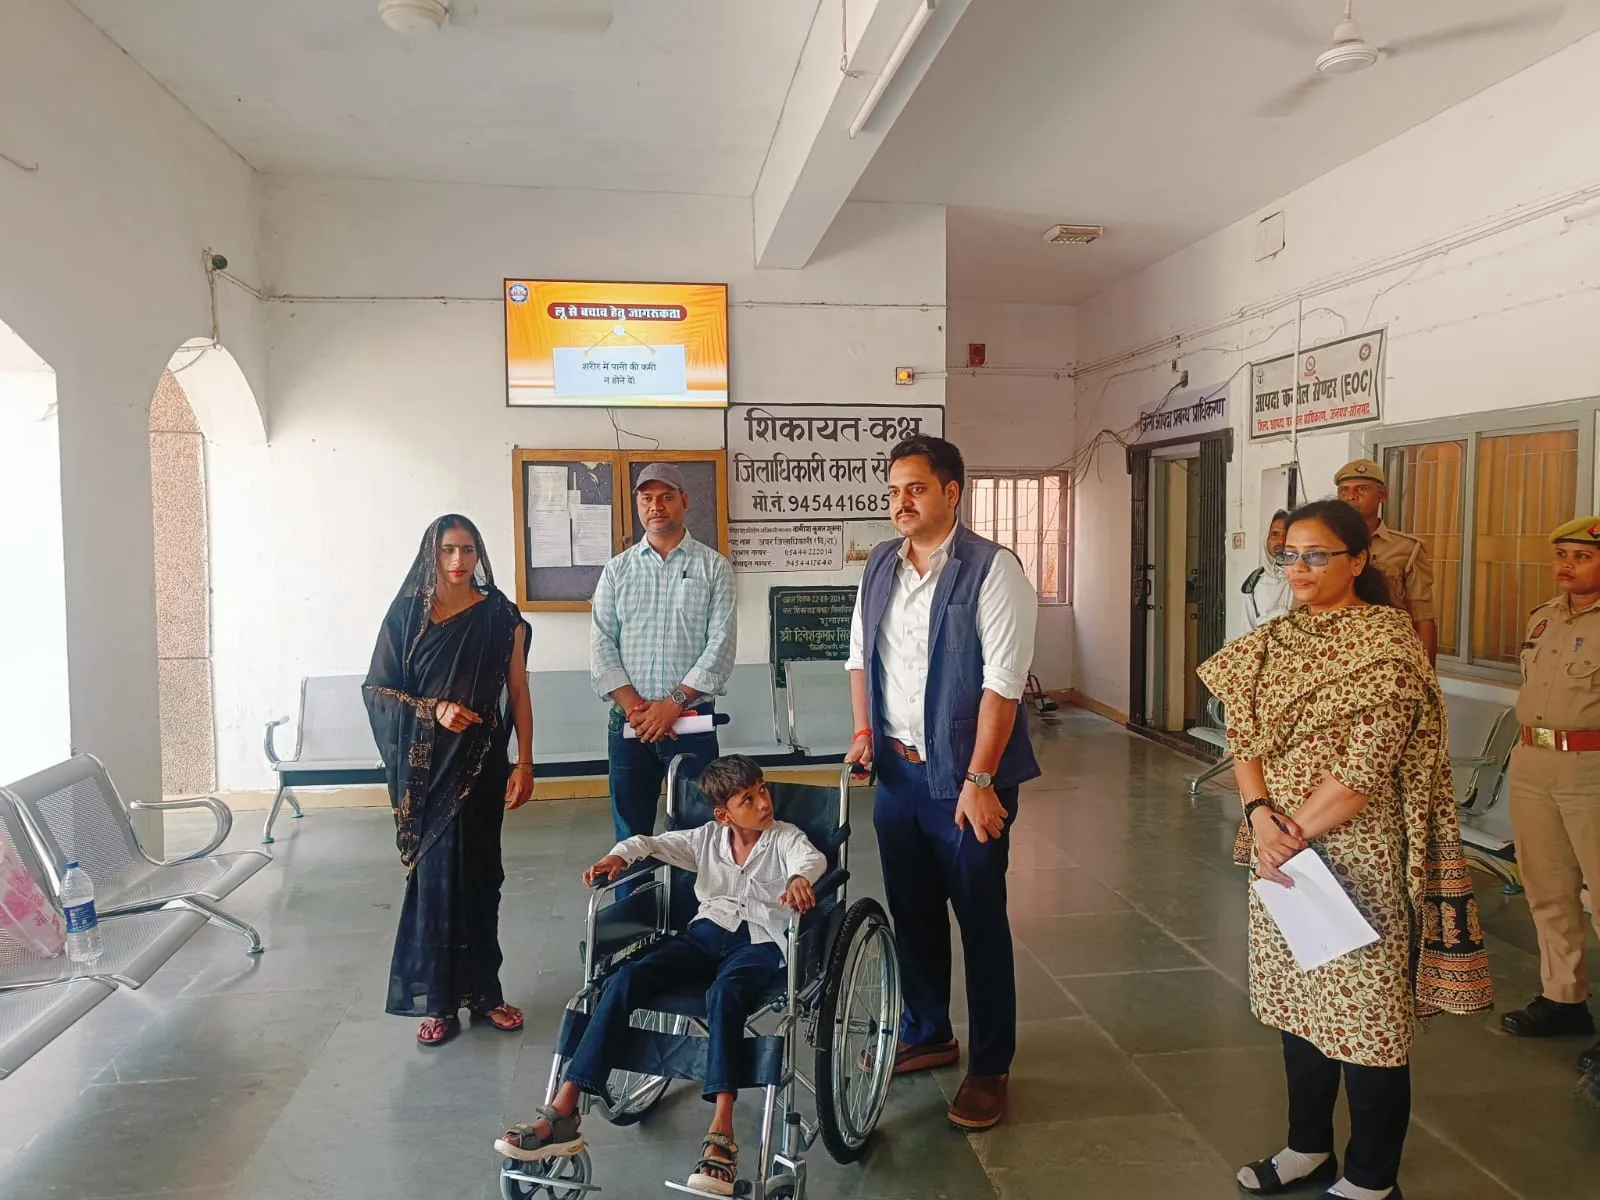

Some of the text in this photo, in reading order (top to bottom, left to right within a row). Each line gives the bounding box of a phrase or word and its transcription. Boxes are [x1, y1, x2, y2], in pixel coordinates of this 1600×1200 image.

[555, 306, 568, 320] लू
[568, 304, 578, 317] से
[581, 307, 608, 317] बचाव
[610, 305, 626, 320] हेतु
[582, 360, 657, 371] शरीर में पानी की कमी
[604, 376, 610, 385] न
[612, 374, 625, 385] होने
[1255, 390, 1280, 413] आपदा
[1341, 368, 1373, 402] (EOC)
[1141, 411, 1154, 432] जिला
[1155, 411, 1173, 431] आपदा
[1192, 396, 1226, 423] प्राधिकरण
[744, 407, 923, 442] शिकायत-कक्ष
[1270, 417, 1286, 430] आपदा
[732, 452, 891, 484] जिलाधिकारी काल से
[789, 494, 891, 513] 945441685
[774, 536, 812, 546] जिलाधिकारी
[779, 627, 792, 642] श्री
